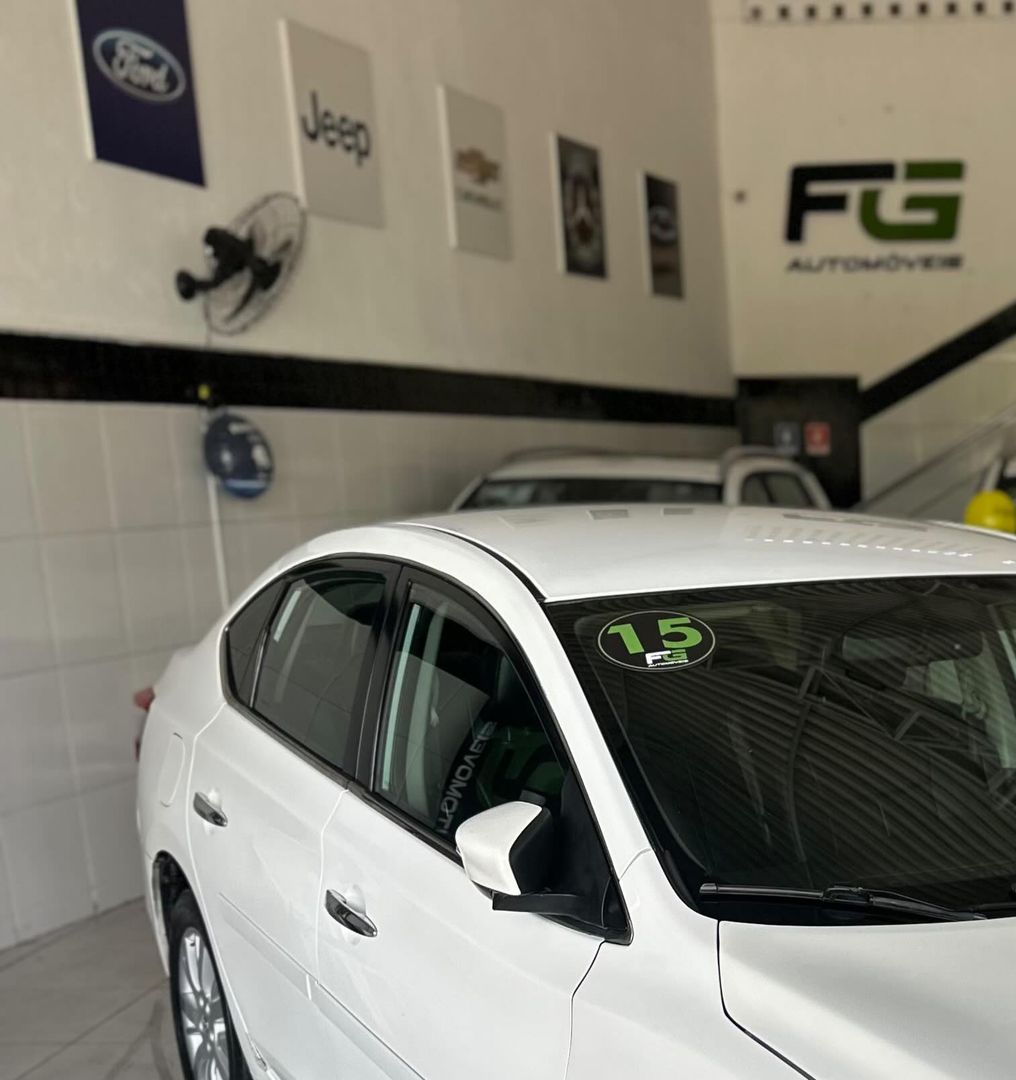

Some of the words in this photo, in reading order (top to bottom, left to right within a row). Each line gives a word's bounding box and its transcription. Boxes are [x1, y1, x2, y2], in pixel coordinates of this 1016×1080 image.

[112, 37, 170, 94] Ford
[302, 89, 370, 168] Jeep
[784, 160, 965, 243] FG
[607, 617, 703, 655] 15
[645, 648, 688, 665] FG
